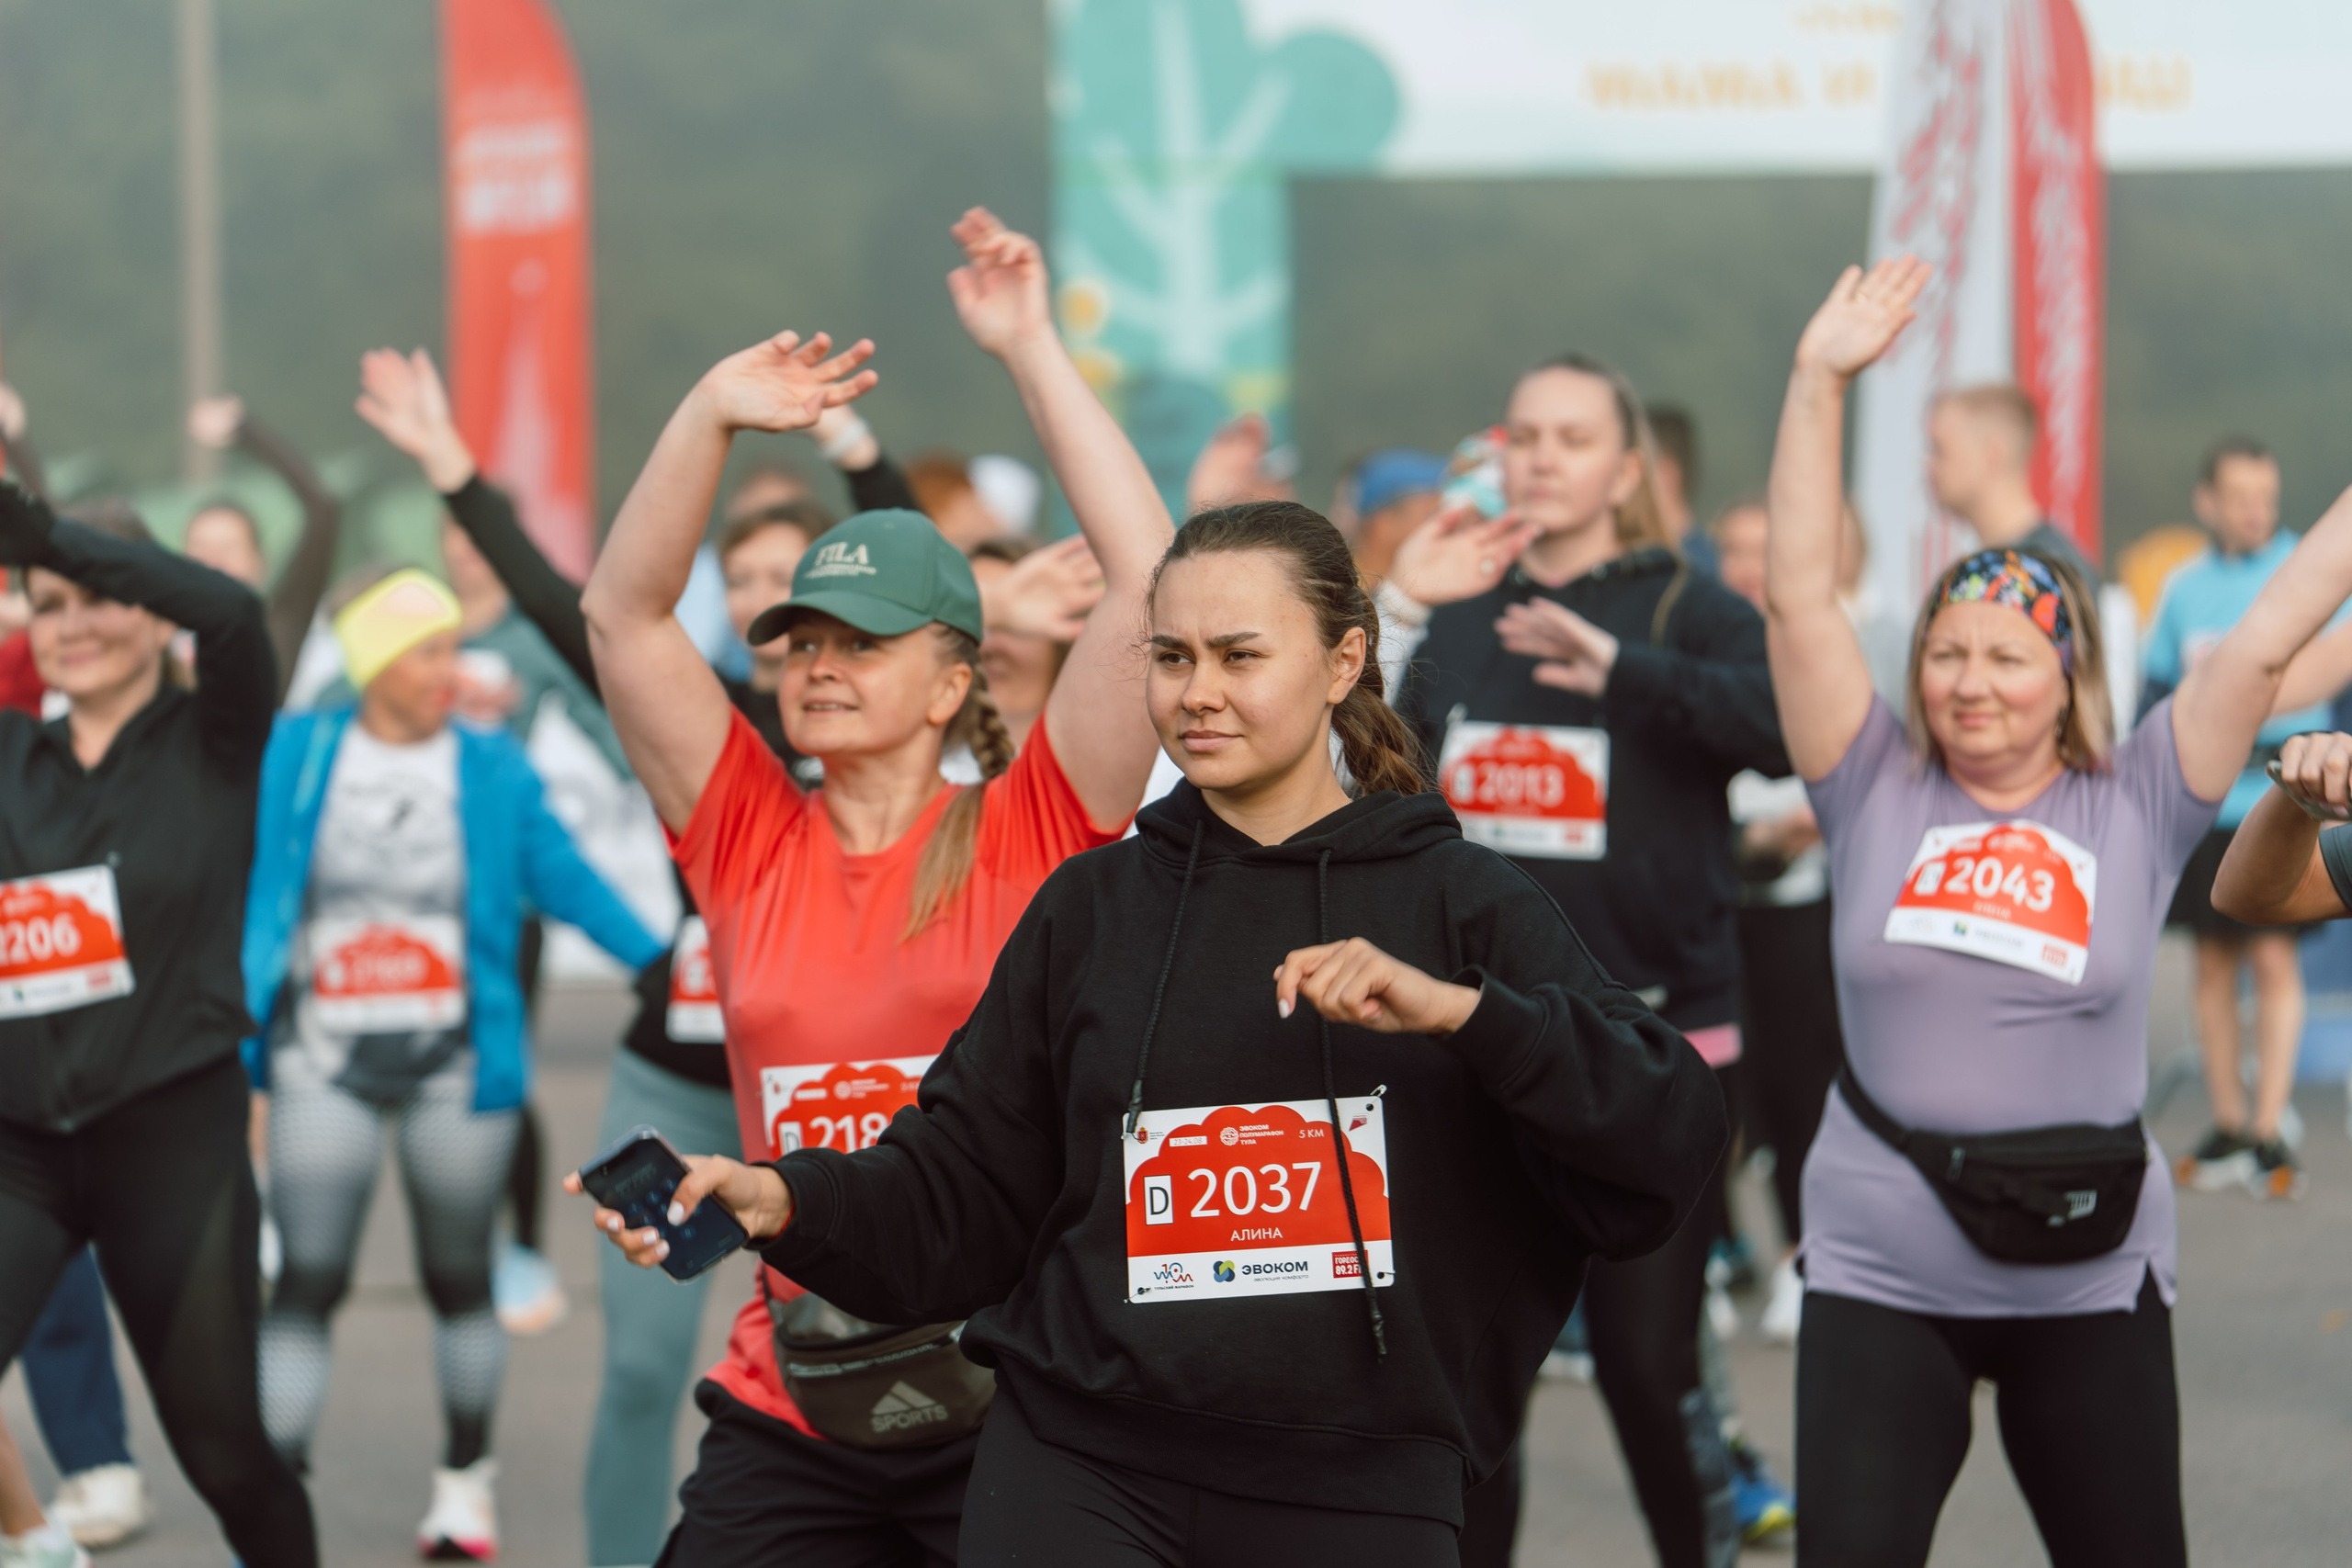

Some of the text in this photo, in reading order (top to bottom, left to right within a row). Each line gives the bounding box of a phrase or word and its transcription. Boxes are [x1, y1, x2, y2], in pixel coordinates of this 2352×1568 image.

[815, 542, 868, 566] FILA
[1944, 856, 2055, 912] 2043
[1239, 1130, 1284, 1138] ПОЛУМАРАФОН
[1299, 1130, 1306, 1138] 5
[1188, 1161, 1321, 1218] 2037
[1149, 1186, 1169, 1215] D
[1230, 1227, 1283, 1241] АЛИНА
[1241, 1261, 1308, 1275] ЭВОКОМ
[1335, 1265, 1353, 1276] 89.2
[871, 1404, 949, 1433] SPORTS
